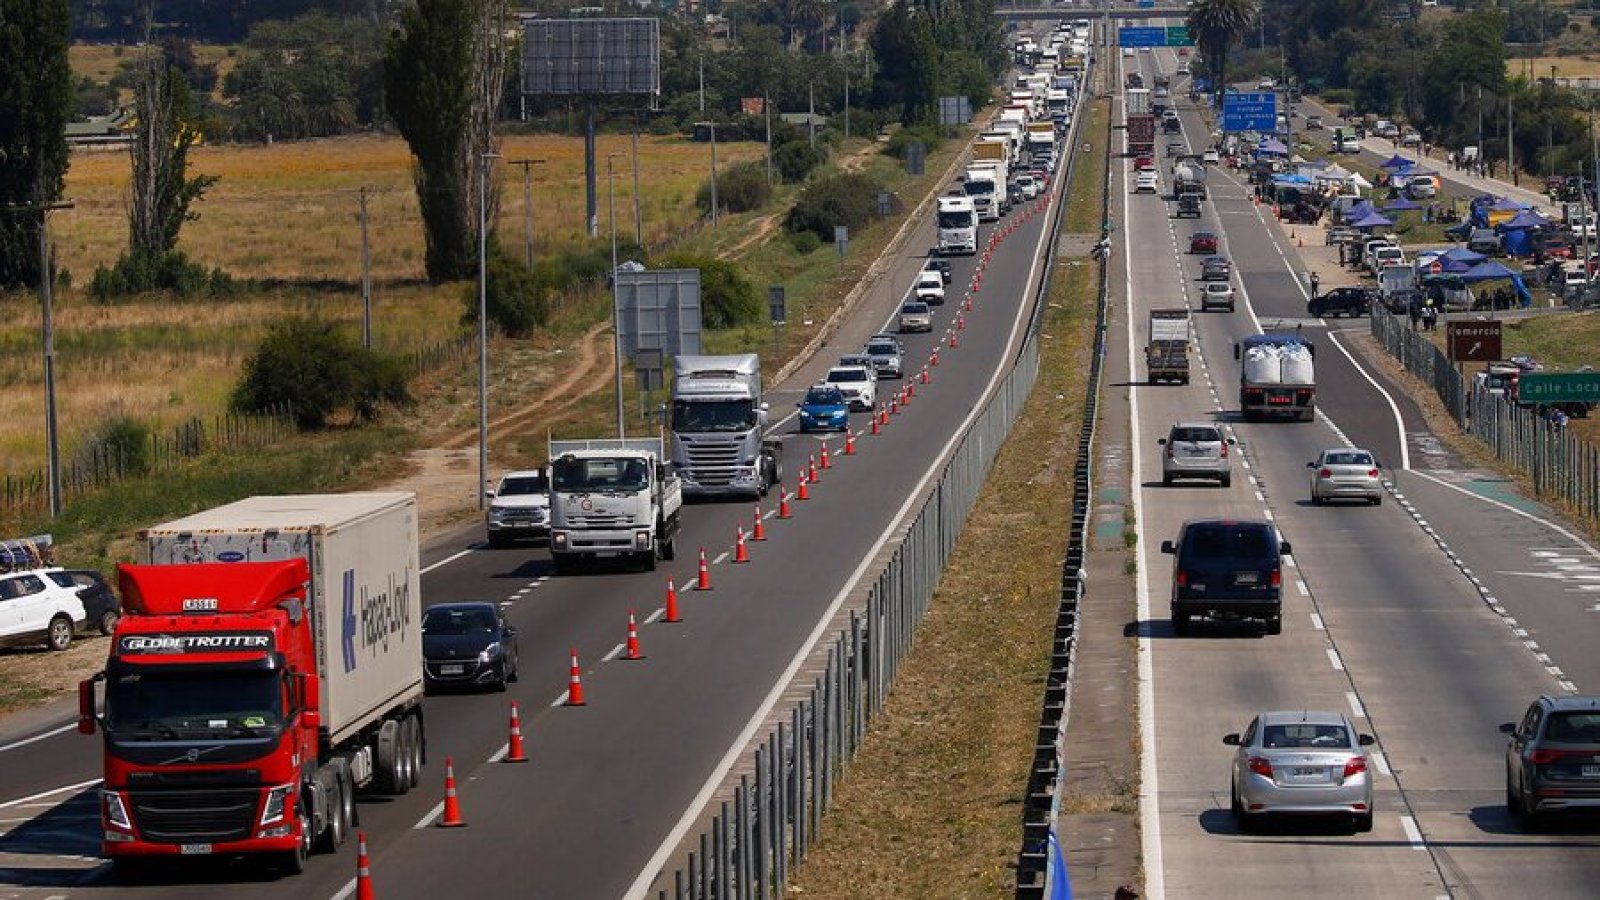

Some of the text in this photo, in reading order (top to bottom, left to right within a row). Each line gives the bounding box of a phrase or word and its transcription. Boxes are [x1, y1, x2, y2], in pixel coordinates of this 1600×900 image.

[1448, 326, 1500, 337] Comercio
[1525, 383, 1561, 394] Calle
[360, 565, 410, 660] Hapag-Lloyd
[128, 636, 269, 650] GLOBETROTTER
